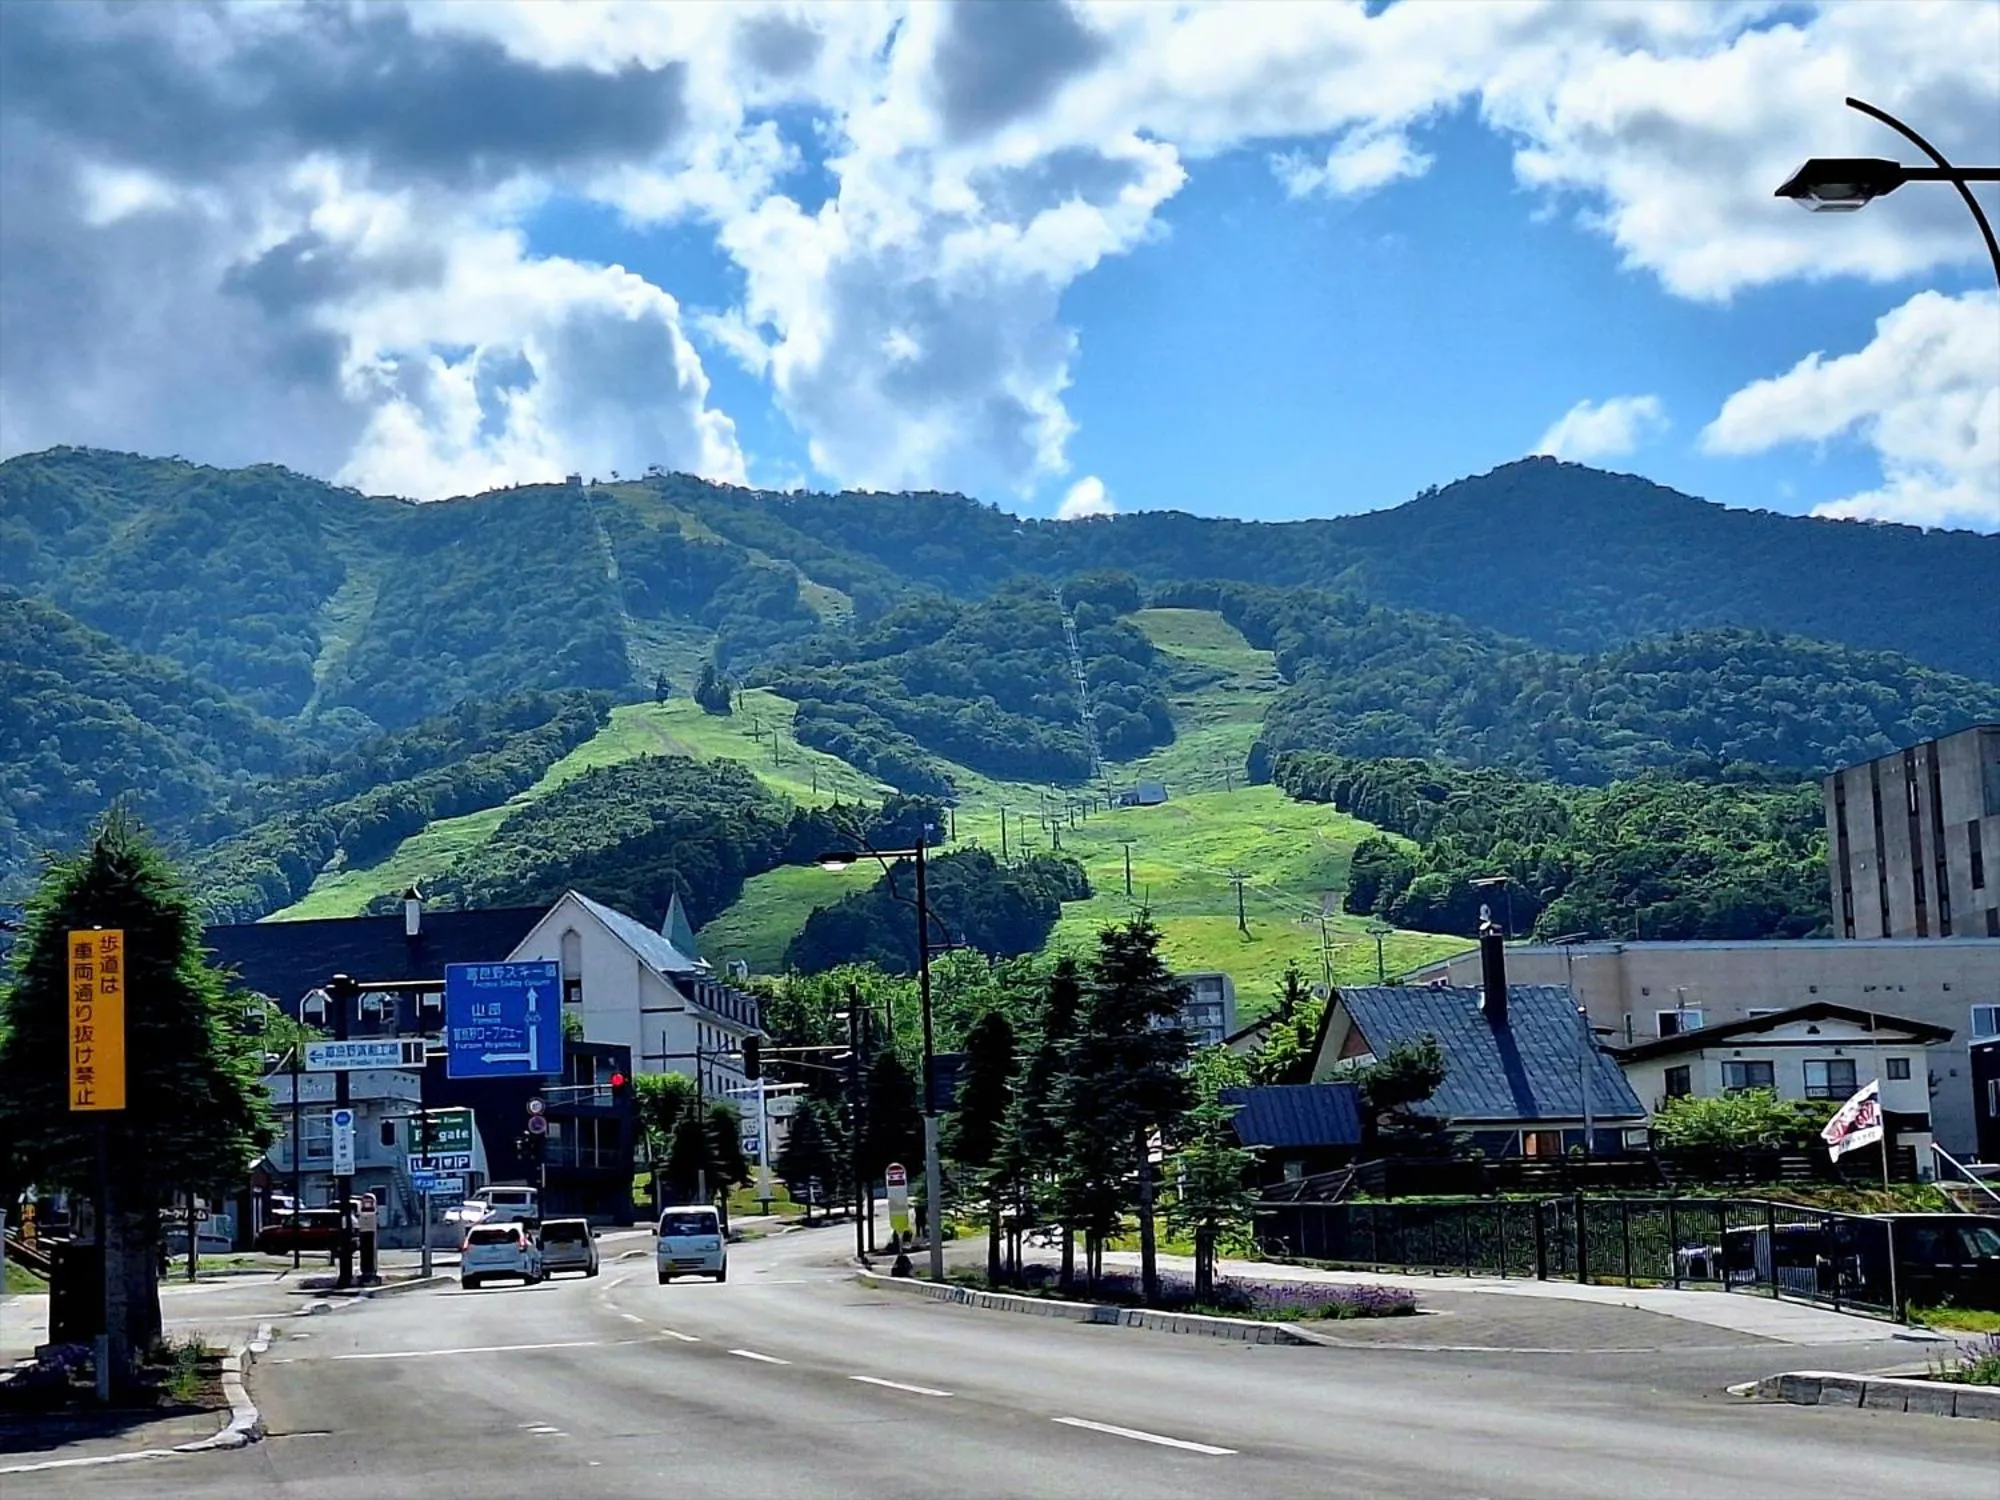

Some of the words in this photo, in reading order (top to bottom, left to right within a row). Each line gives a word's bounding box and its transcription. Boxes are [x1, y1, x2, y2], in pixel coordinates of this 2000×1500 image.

[99, 935, 120, 994] 歩道は
[73, 942, 95, 1106] 車両通り抜け禁止
